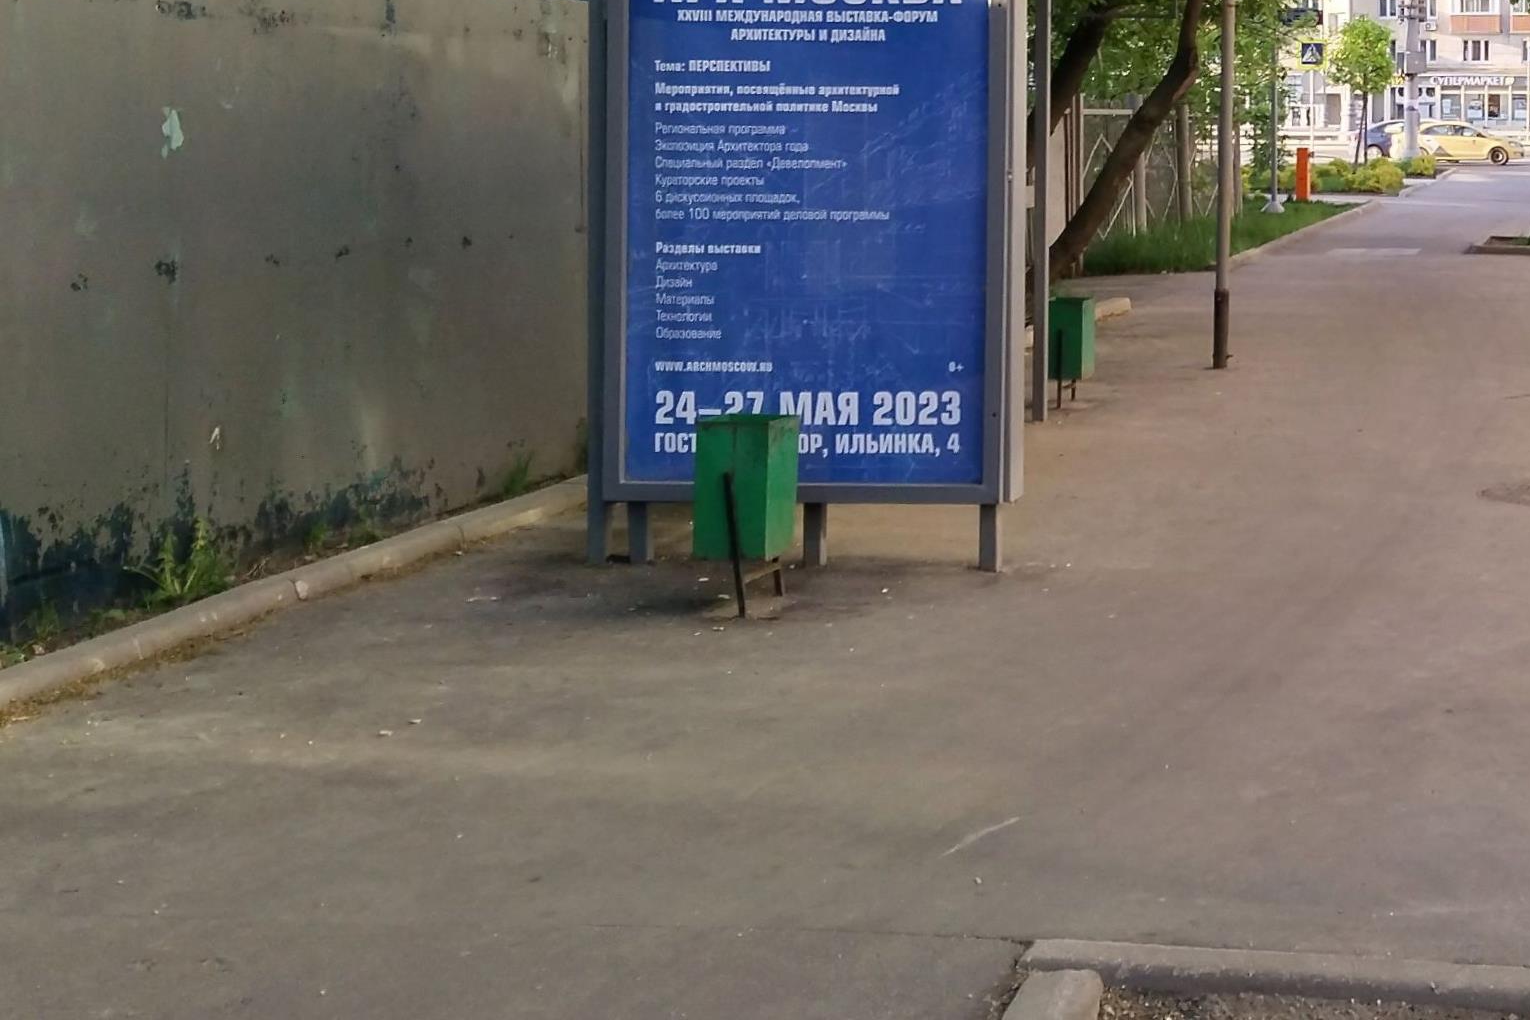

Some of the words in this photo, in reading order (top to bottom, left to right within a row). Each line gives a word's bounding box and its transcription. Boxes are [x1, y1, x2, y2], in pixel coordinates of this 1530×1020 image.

[677, 10, 712, 22] XXVIII
[715, 10, 823, 23] МЕЖДУНАРОДНАЯ
[826, 10, 938, 23] ВЫСТАВКА-ФОРУМ
[730, 28, 815, 41] АРХИТЕКТУРЫ
[818, 29, 827, 40] И
[830, 27, 886, 43] ДИЗАЙНА
[655, 60, 685, 72] Тема:
[688, 60, 771, 72] ПЕРСПЕКТИВЫ
[1430, 76, 1506, 85] СУПЕРМАРКЕТ
[655, 83, 734, 97] Мероприятия,
[737, 83, 815, 96] посвящённые
[818, 83, 899, 97] архитектурной
[665, 100, 773, 114] градостроительной
[776, 102, 829, 112] политике
[832, 101, 878, 112] Москвы
[655, 122, 725, 134] Региональная
[728, 125, 786, 136] программа
[655, 140, 714, 152] Экспозиция
[717, 140, 782, 152] Архитектора
[785, 143, 808, 152] года
[655, 156, 723, 169] Специальный
[726, 159, 763, 170] раздел
[655, 174, 718, 187] Кураторские
[721, 177, 764, 187] проекты
[655, 191, 662, 203] 6
[655, 208, 684, 220] более
[689, 208, 710, 220] 100
[712, 209, 780, 222] мероприятий
[783, 209, 827, 221] деловой
[830, 212, 889, 222] программы
[655, 242, 704, 254] Разделы
[707, 244, 761, 253] выставки
[655, 259, 718, 271] Архитектура
[655, 276, 693, 288] Дизайн
[655, 293, 715, 305] Материалы
[655, 310, 712, 322] Технологии
[655, 327, 722, 339] Образование
[779, 391, 859, 425] МАЯ
[872, 390, 961, 425] 2023
[655, 433, 697, 453] ГОСТ
[799, 434, 829, 458] ОР,
[835, 433, 940, 456] ИЛЬИНКА,
[947, 434, 960, 453] 4
